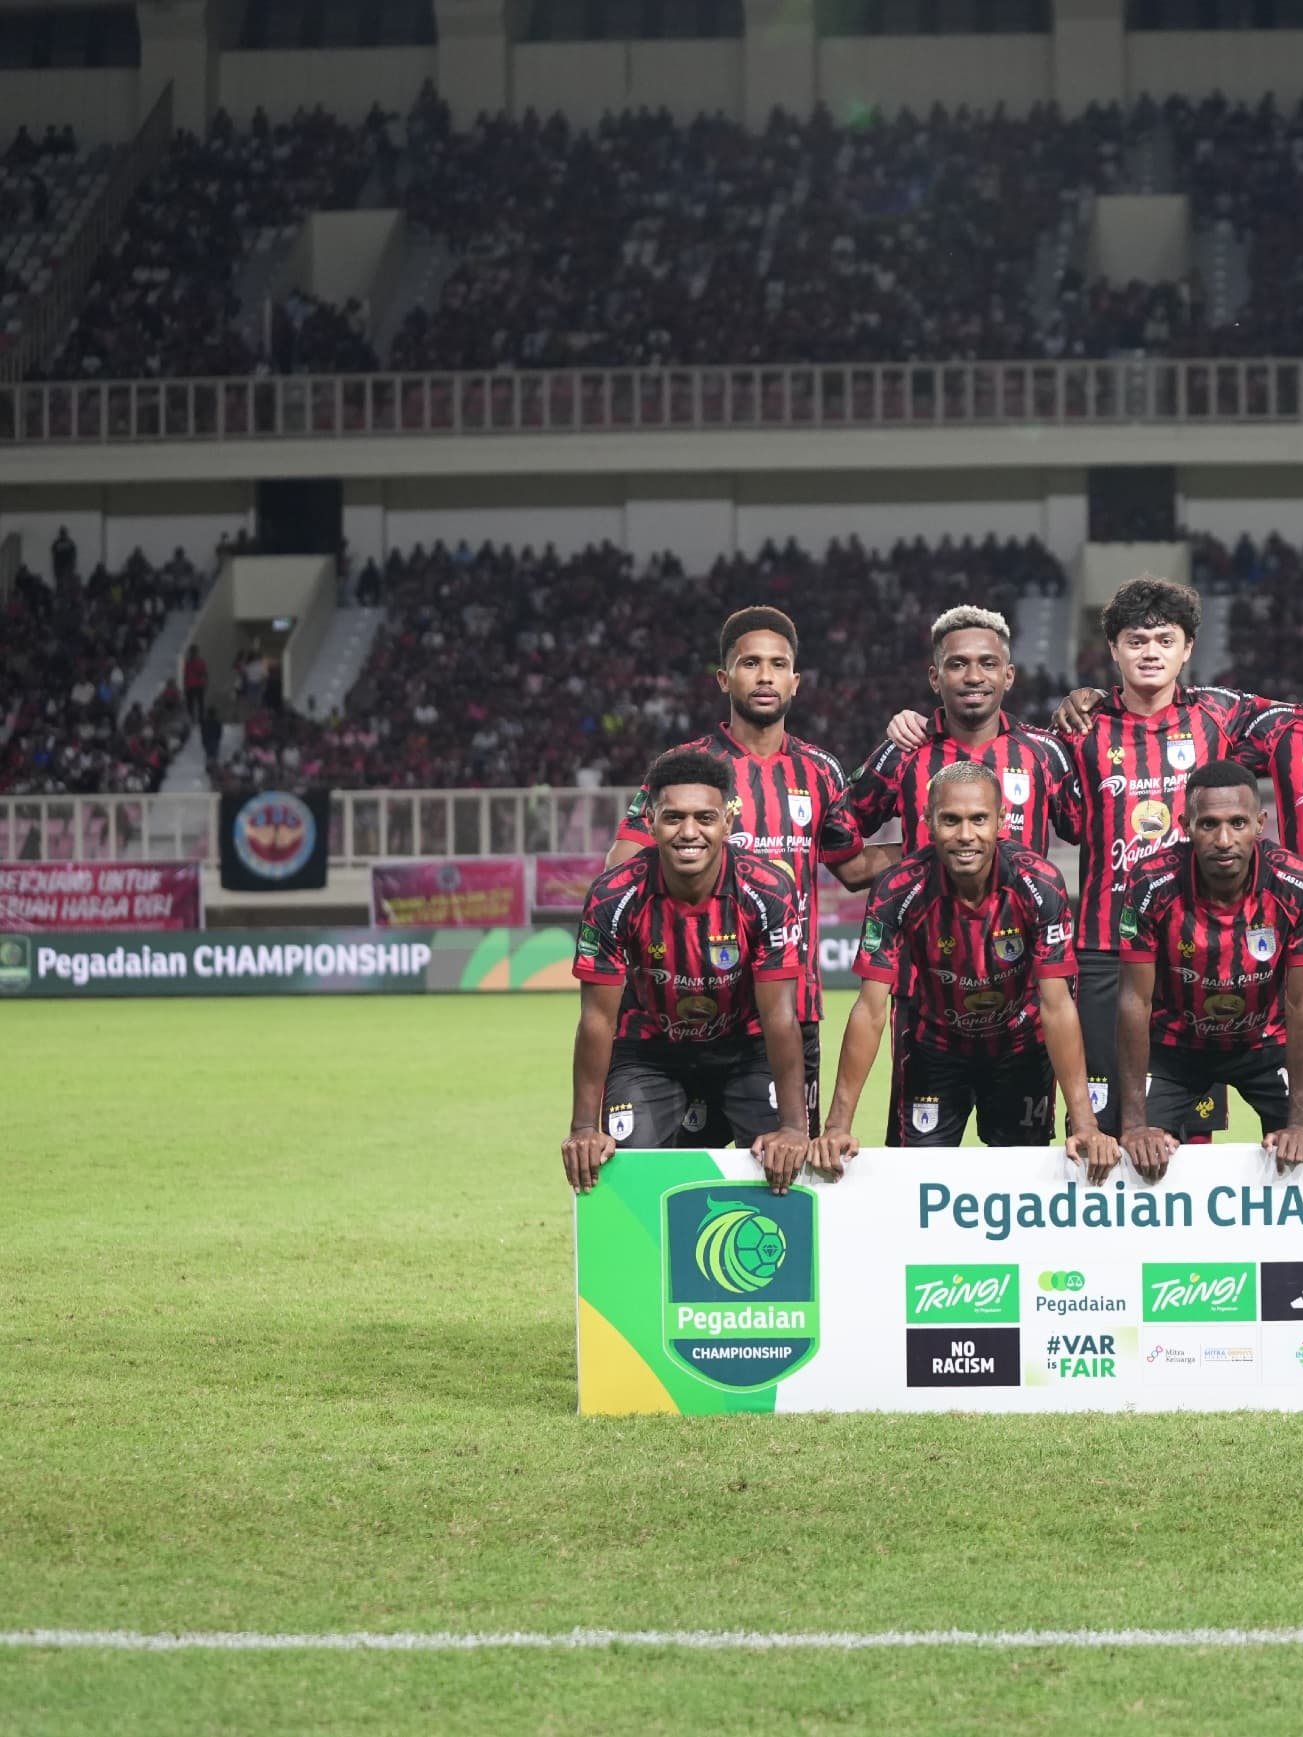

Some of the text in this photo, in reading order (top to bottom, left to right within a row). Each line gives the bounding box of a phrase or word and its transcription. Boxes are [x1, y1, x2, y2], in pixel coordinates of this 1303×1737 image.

[1129, 777, 1161, 790] BANK
[754, 836, 784, 848] BANK
[1112, 883, 1126, 892] Jel
[37, 943, 432, 986] Pegadaian CHAMPIONSHIP
[673, 975, 705, 987] BANK
[959, 976, 991, 987] BANK
[1202, 969, 1274, 987] BANK PAPUA
[1020, 1095, 1049, 1126] 14
[919, 1180, 1193, 1241] Pegadaian
[1036, 1296, 1126, 1316] Pegadaian
[678, 1306, 806, 1335] Pegadaian
[692, 1347, 792, 1359] CHAMPIONSHIP
[951, 1341, 976, 1357] NO
[1047, 1335, 1117, 1355] #VAR
[1165, 1348, 1185, 1356] Mitra
[932, 1358, 994, 1374] RACISM
[1047, 1358, 1117, 1378] is FAIR
